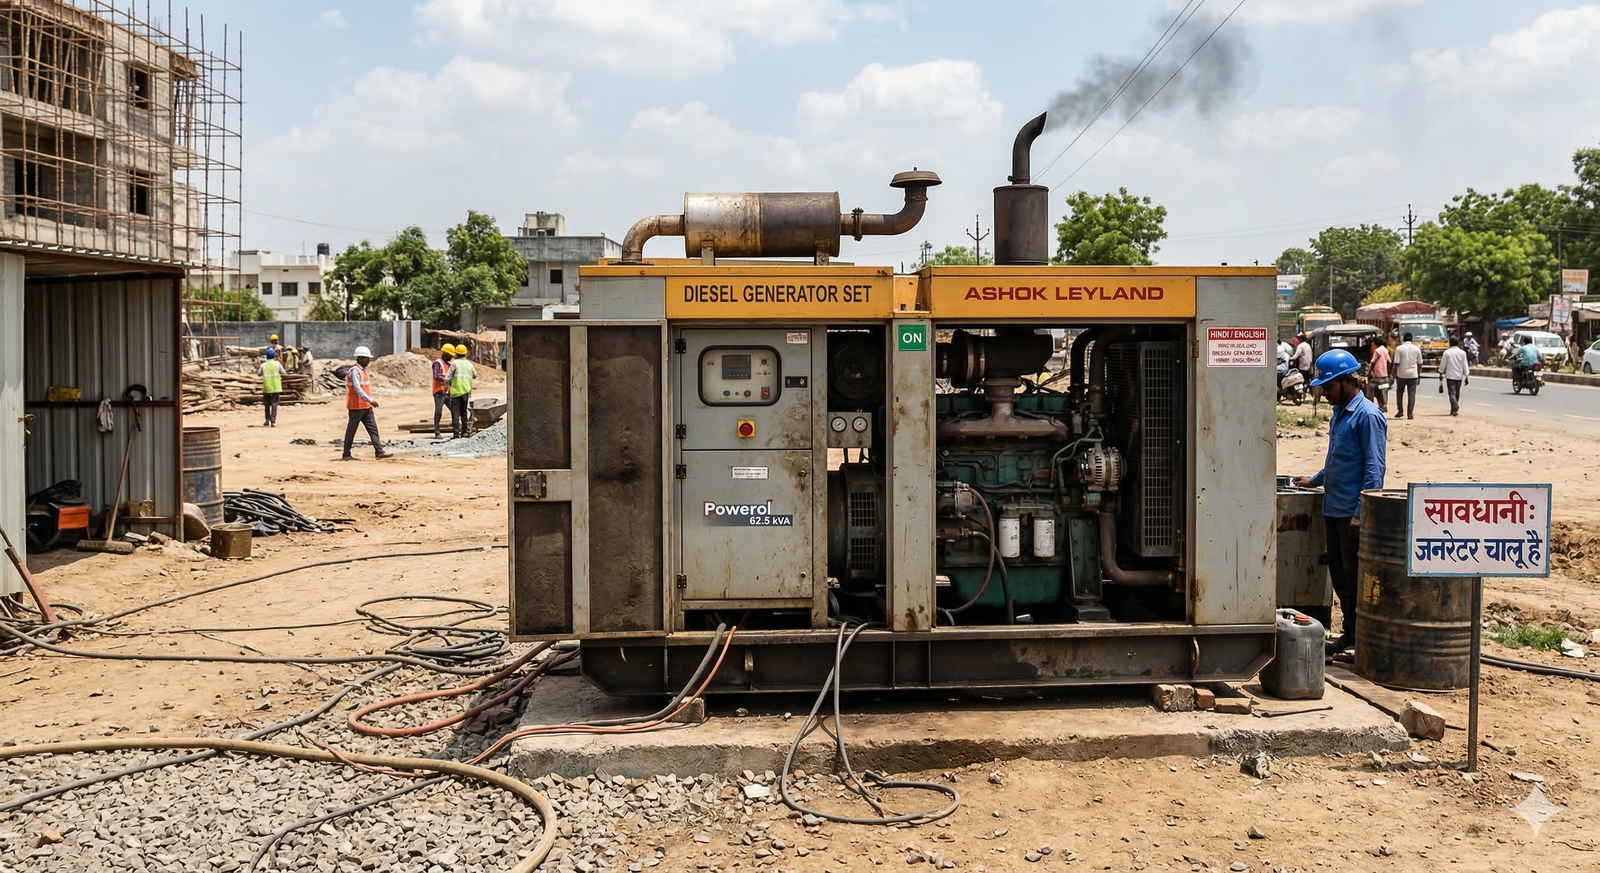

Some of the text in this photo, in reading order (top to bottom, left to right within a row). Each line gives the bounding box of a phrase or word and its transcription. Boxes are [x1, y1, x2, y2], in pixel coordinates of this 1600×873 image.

[684, 285, 873, 303] DIESEL GENERATOR SET
[964, 286, 1164, 301] ASHOK LEYLAND
[902, 332, 923, 344] ON
[1210, 330, 1230, 338] HINDI
[1234, 330, 1265, 338] ENGLISH
[704, 501, 771, 515] Powerol
[749, 516, 790, 525] 62.5 kVA
[1415, 529, 1543, 569] जनरेटर चालू है
